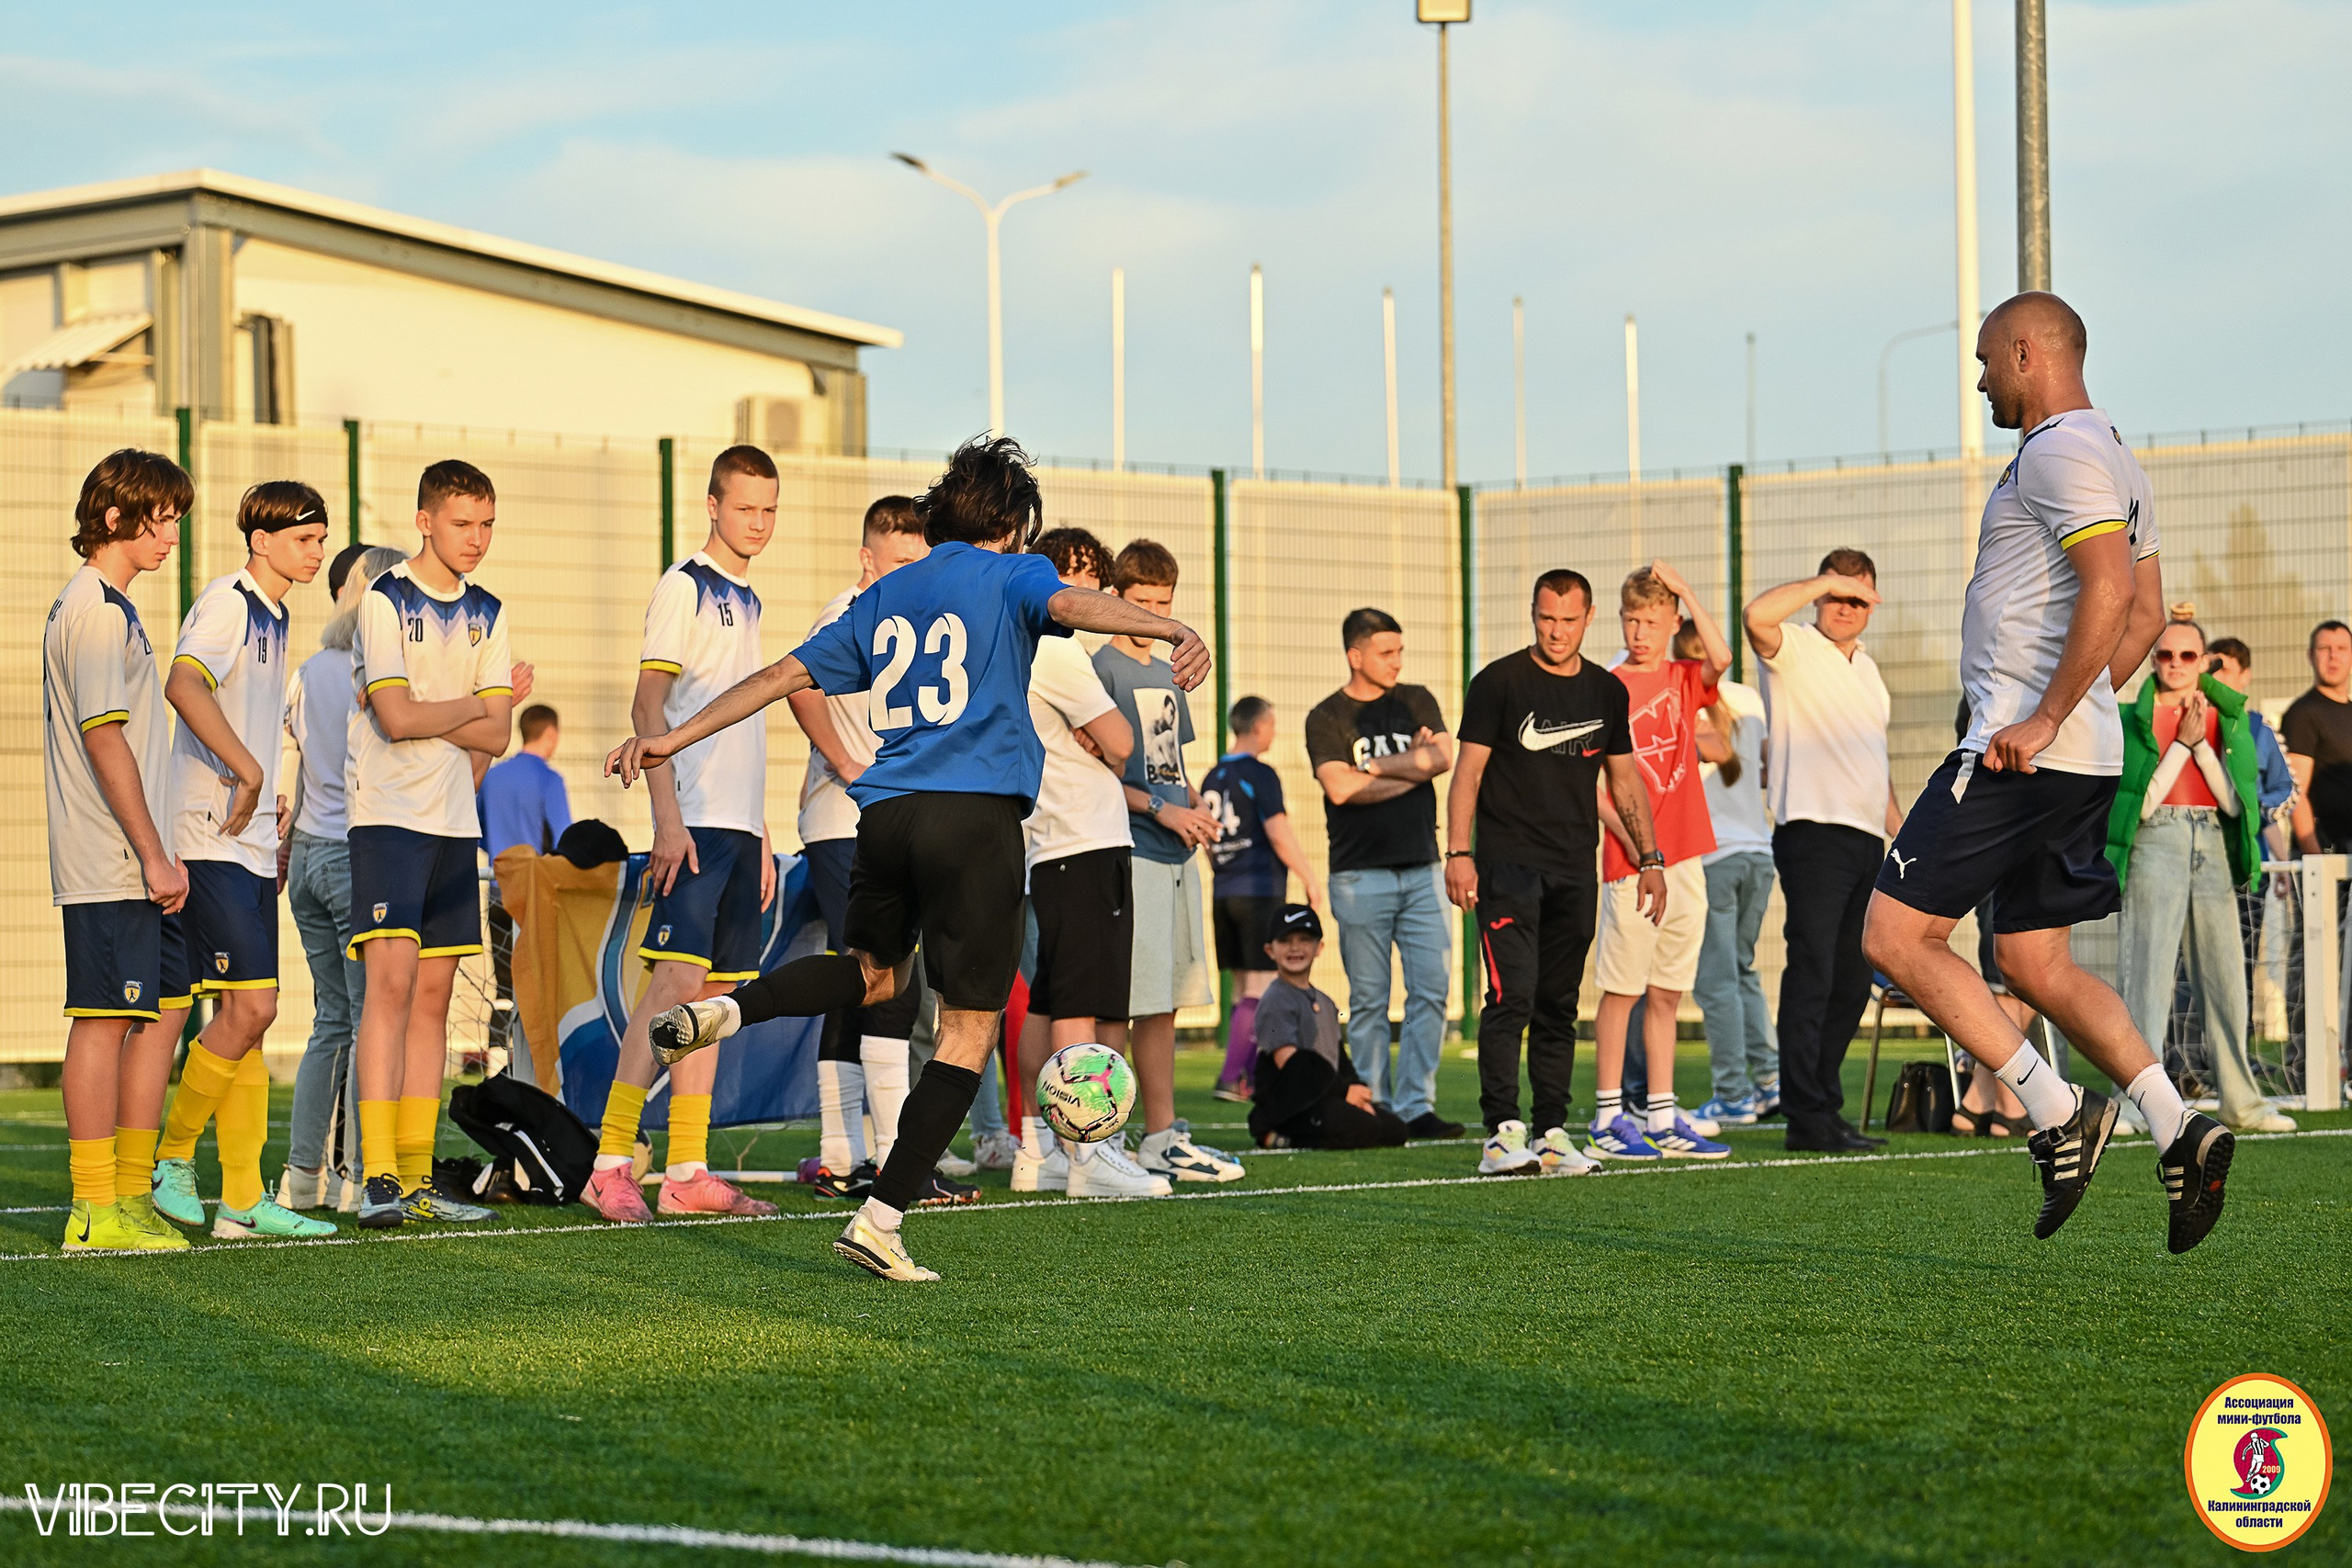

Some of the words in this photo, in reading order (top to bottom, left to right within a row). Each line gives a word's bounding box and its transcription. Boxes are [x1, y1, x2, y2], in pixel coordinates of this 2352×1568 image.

[718, 602, 734, 626] 15
[407, 617, 424, 642] 20
[257, 636, 267, 664] 19
[869, 612, 969, 732] 23
[1042, 1080, 1081, 1108] VISION
